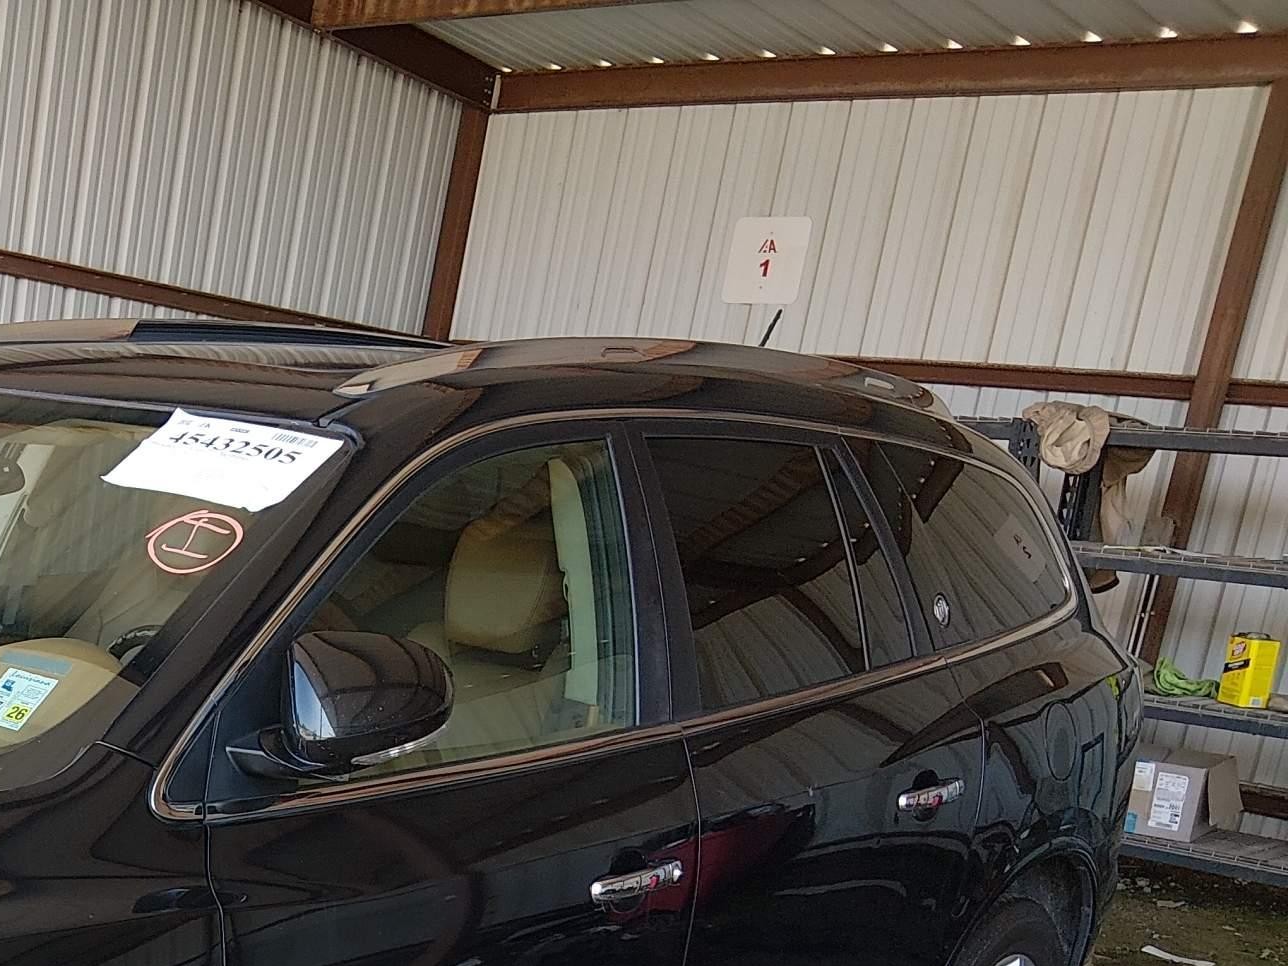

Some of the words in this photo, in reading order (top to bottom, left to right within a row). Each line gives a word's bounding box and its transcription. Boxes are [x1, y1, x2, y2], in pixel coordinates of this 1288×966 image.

[759, 259, 770, 278] 1
[169, 432, 303, 464] 45432505
[6, 706, 28, 720] 26
